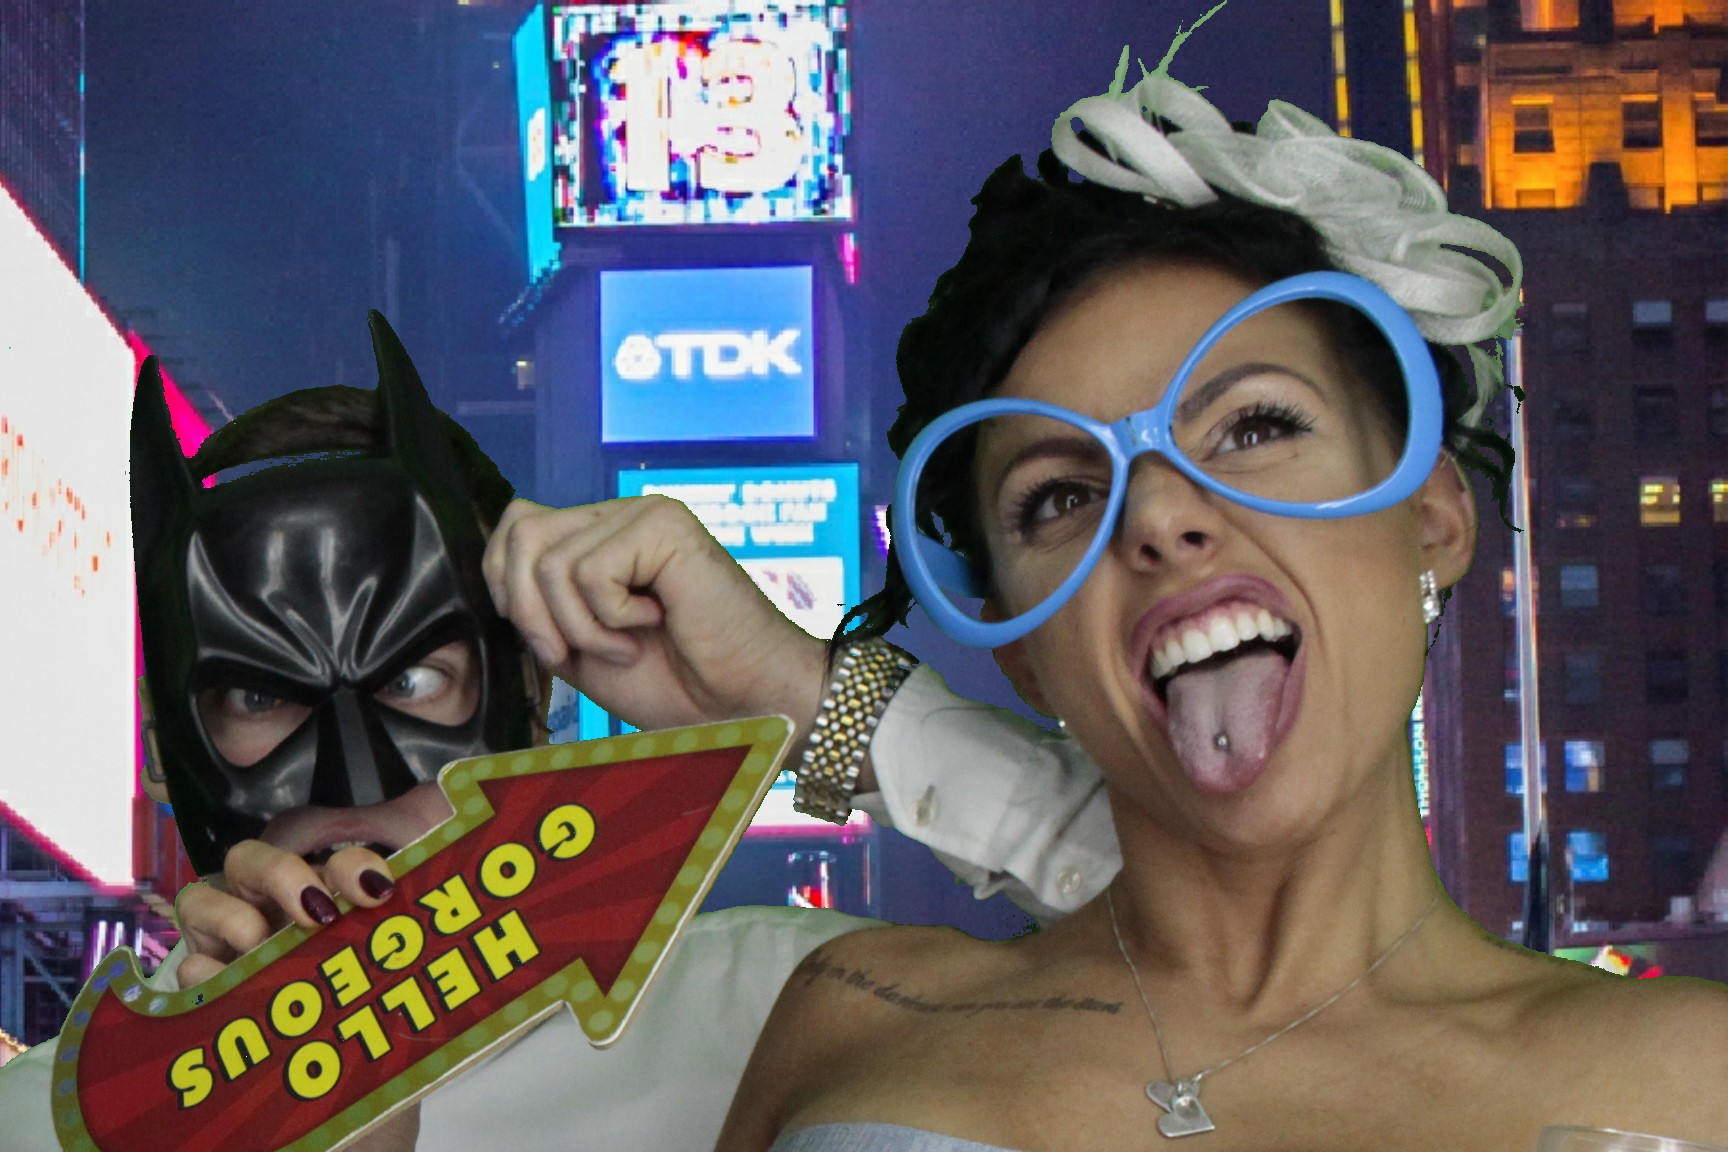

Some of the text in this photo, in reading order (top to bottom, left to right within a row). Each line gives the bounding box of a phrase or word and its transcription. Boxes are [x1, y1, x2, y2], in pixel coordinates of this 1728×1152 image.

[655, 329, 803, 377] TDK
[170, 803, 597, 1108] GORGEOUS
[285, 908, 540, 1099] HELLO
